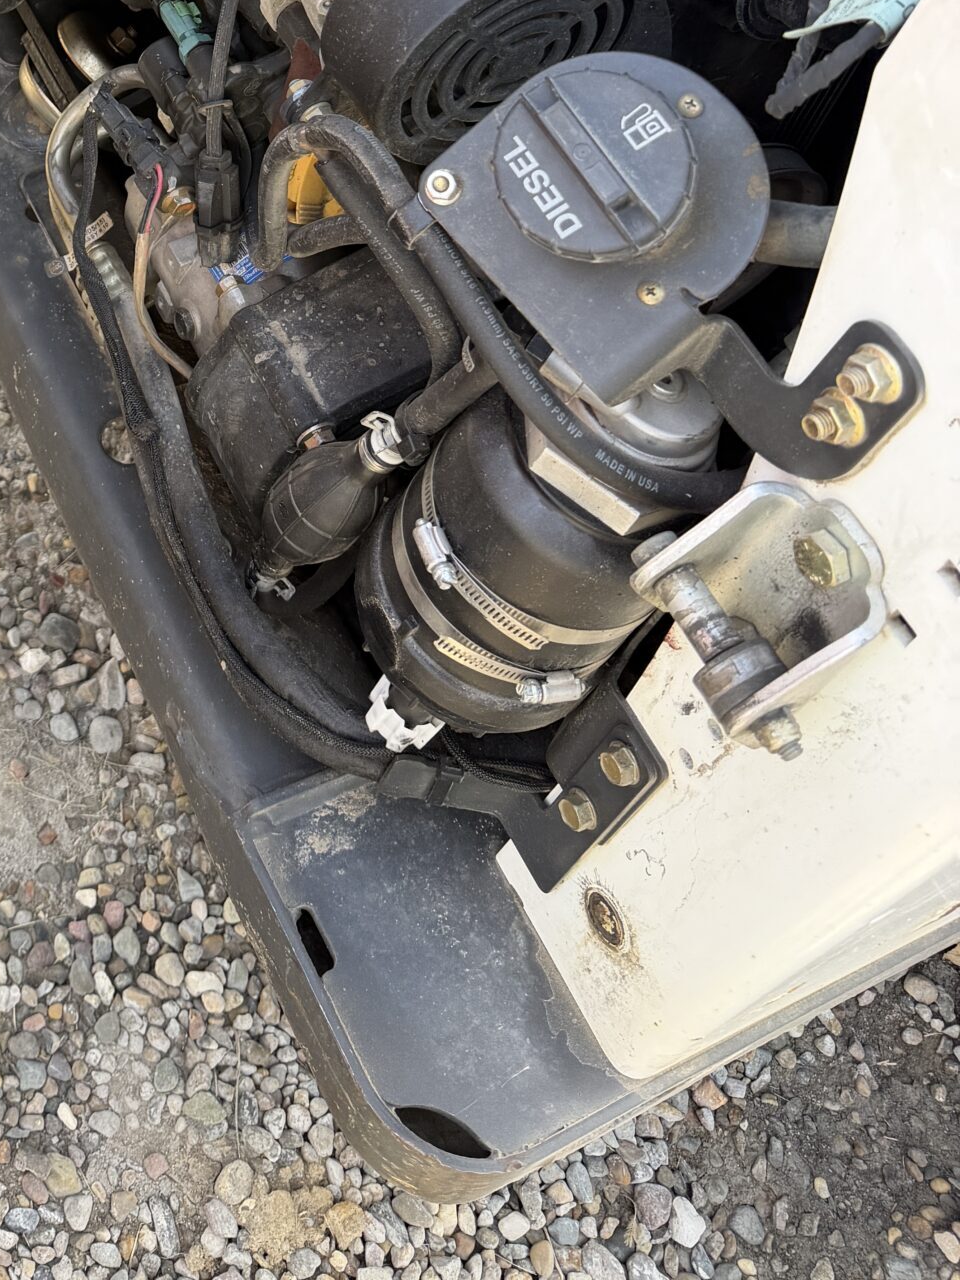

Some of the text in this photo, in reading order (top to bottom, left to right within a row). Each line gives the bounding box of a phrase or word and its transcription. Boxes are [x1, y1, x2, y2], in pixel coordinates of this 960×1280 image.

[503, 135, 583, 240] DIESEL
[502, 337, 519, 362] SAE
[516, 360, 542, 394] J30R7
[540, 393, 553, 408] 50
[551, 406, 569, 426] PSI
[566, 420, 585, 440] WP
[594, 448, 627, 478] MADE
[624, 468, 638, 489] IN
[637, 473, 661, 495] USA
